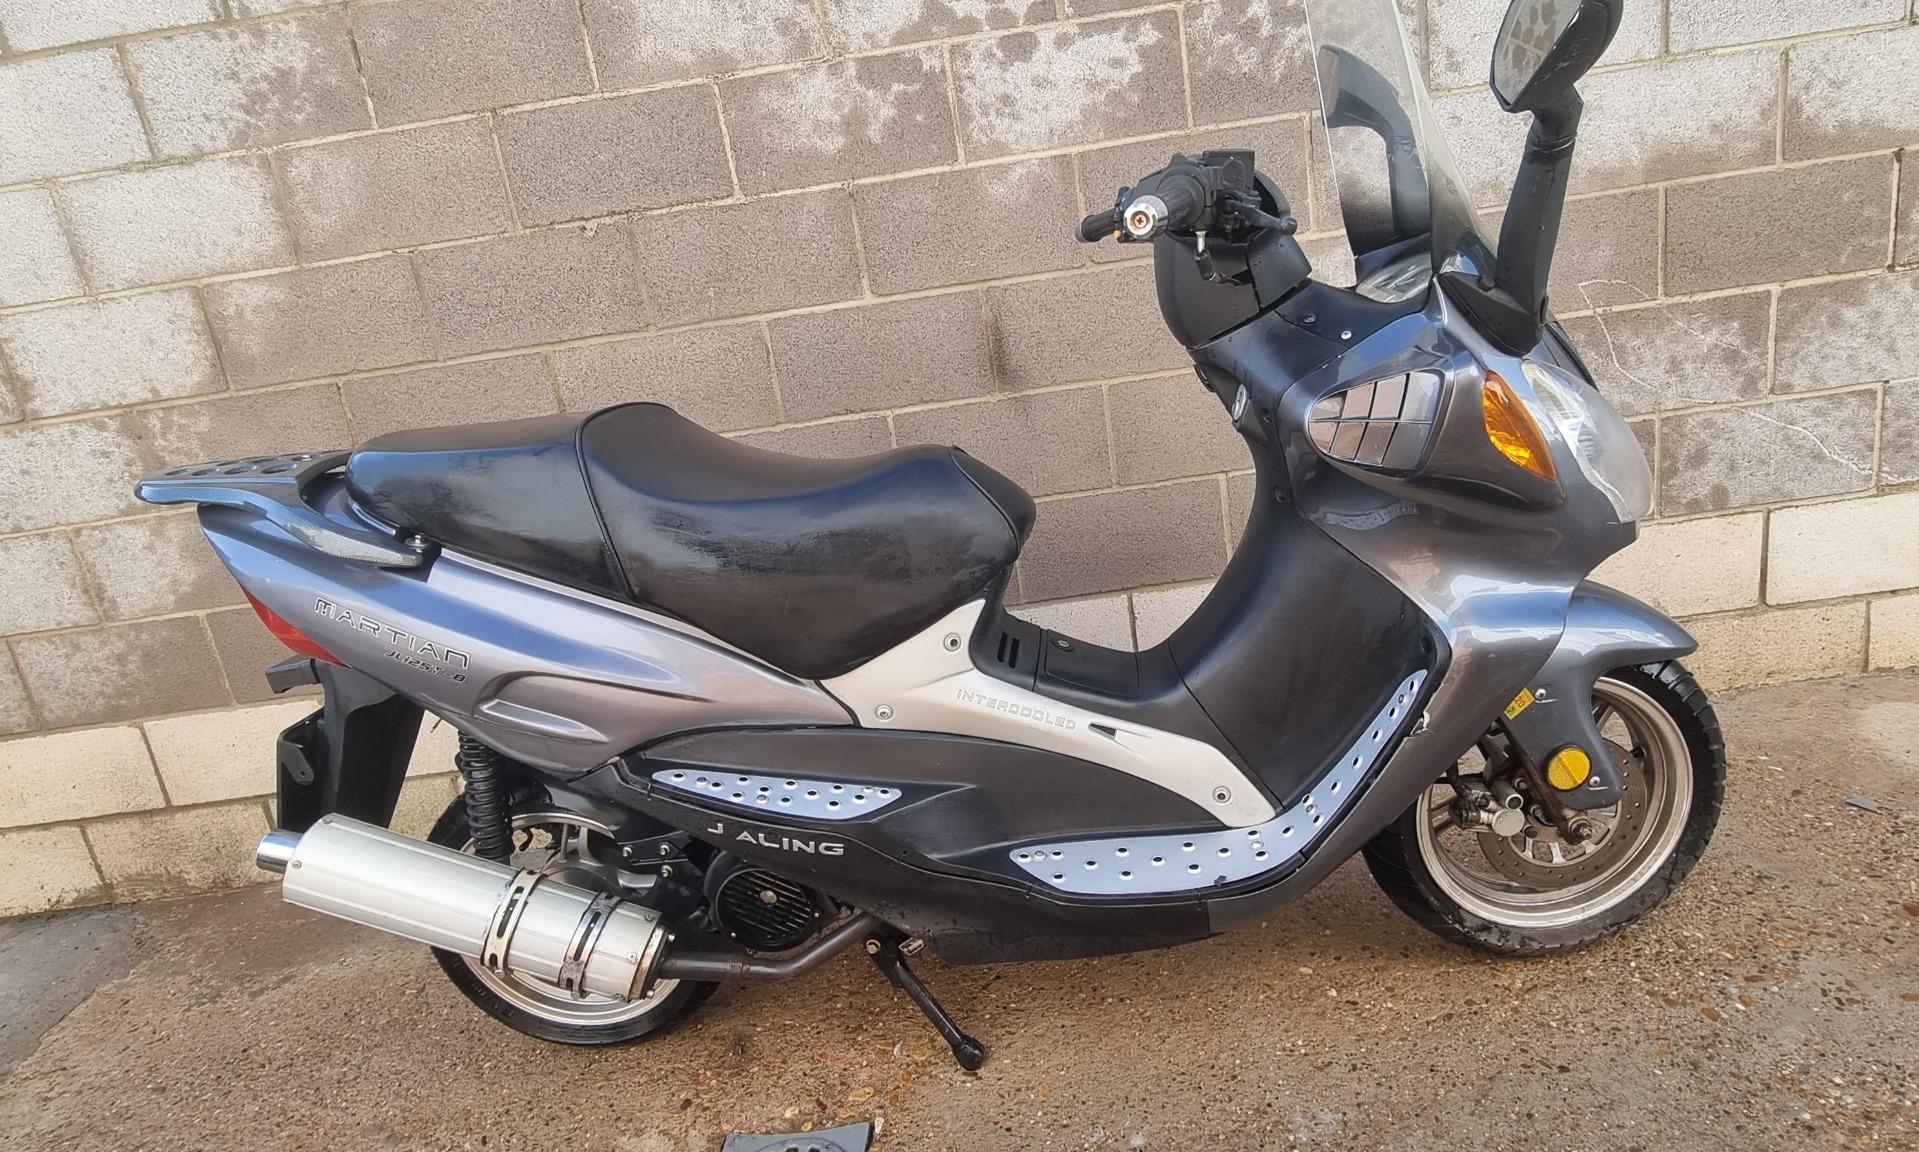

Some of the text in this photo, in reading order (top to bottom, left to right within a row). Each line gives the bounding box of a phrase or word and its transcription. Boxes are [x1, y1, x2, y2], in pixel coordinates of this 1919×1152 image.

[315, 597, 471, 670] MARTIAN
[956, 689, 1076, 730] INTERCOOLED
[736, 830, 844, 856] ALING
